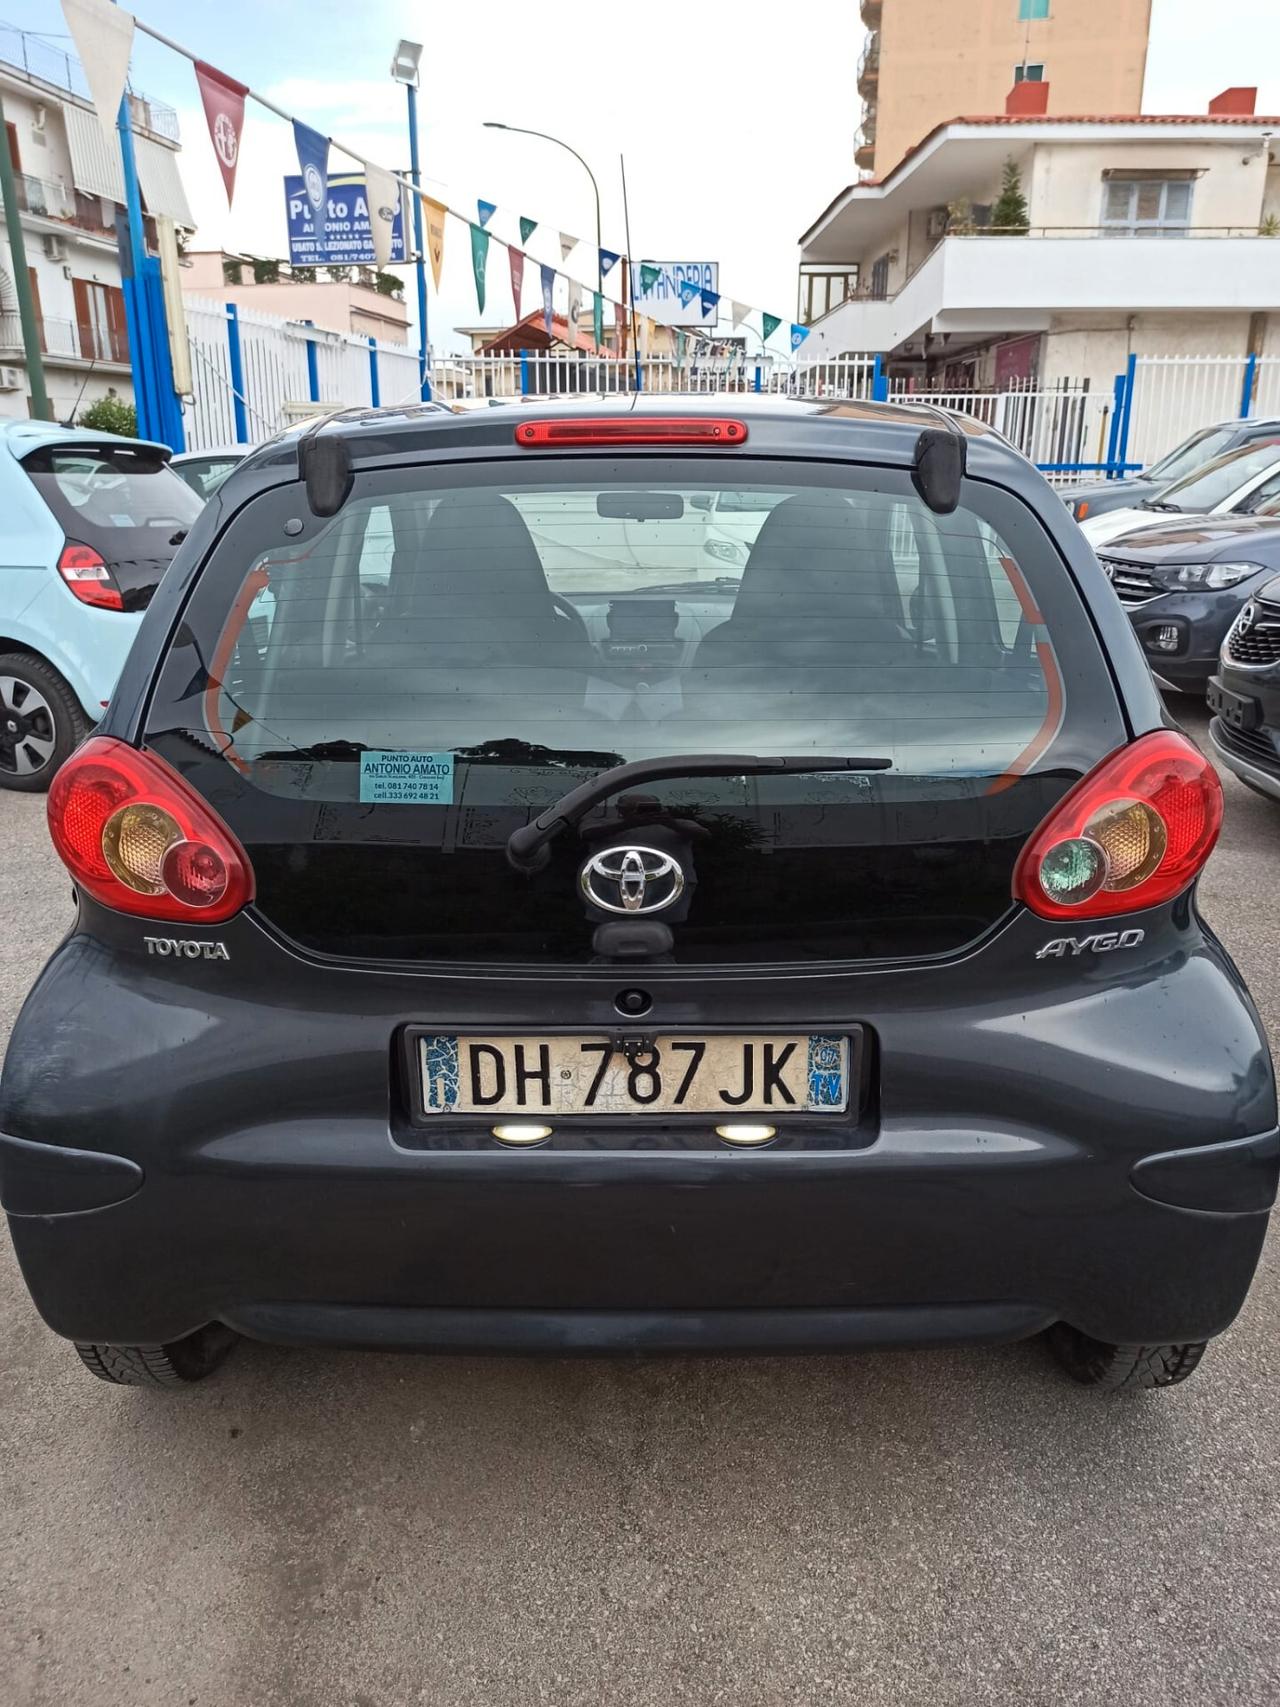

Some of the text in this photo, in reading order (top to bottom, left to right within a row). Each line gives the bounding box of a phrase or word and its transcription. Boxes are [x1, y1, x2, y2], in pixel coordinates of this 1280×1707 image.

[290, 199, 348, 220] Puto
[411, 755, 433, 763] AUTO
[364, 763, 450, 775] ANTONIO AMATO
[387, 782, 402, 790] 081
[403, 792, 417, 800] 692
[143, 936, 231, 960] TOYOTA
[1035, 928, 1145, 960] AYGO
